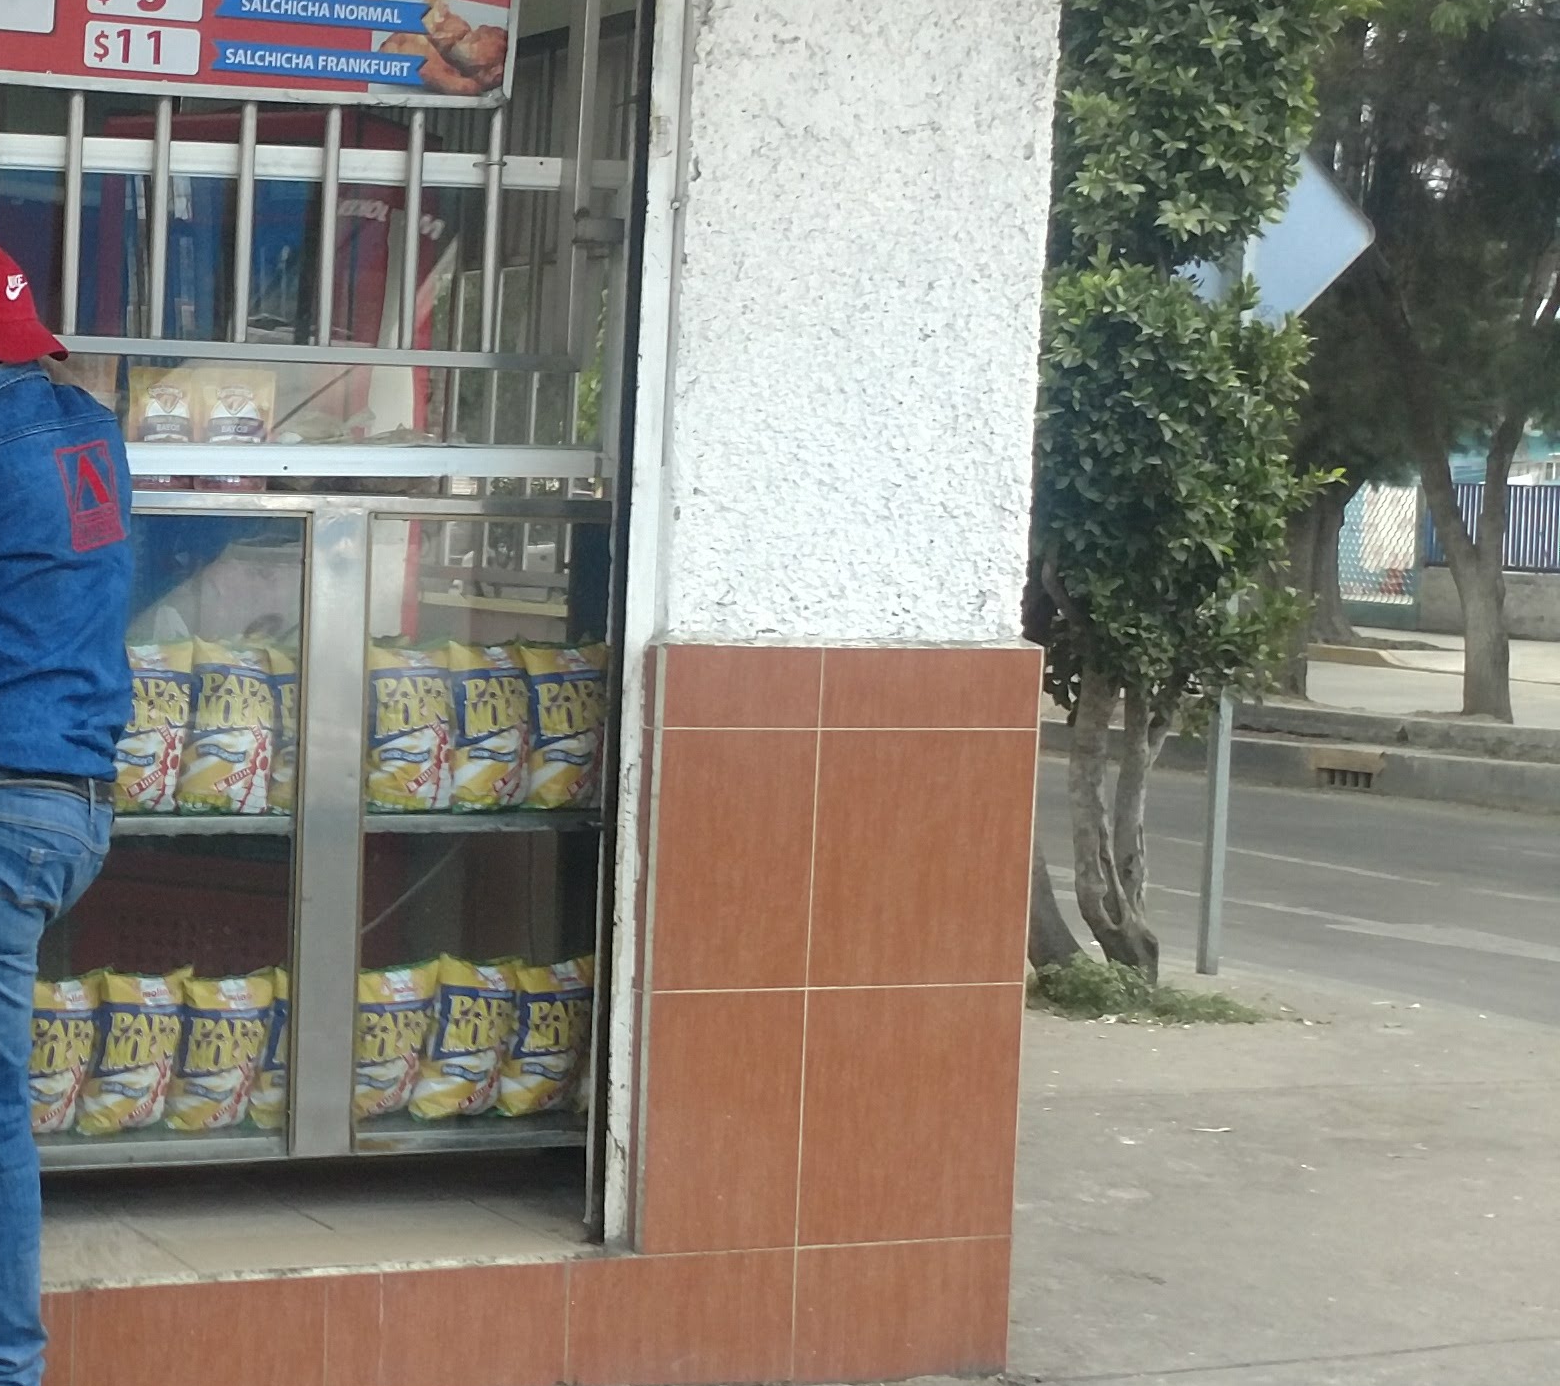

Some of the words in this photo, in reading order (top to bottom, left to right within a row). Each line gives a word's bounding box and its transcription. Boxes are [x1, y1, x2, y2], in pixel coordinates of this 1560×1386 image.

[333, 3, 402, 24] NORMAL
[225, 47, 314, 71] SALCHICHA
[317, 55, 411, 77] FRANKFURT
